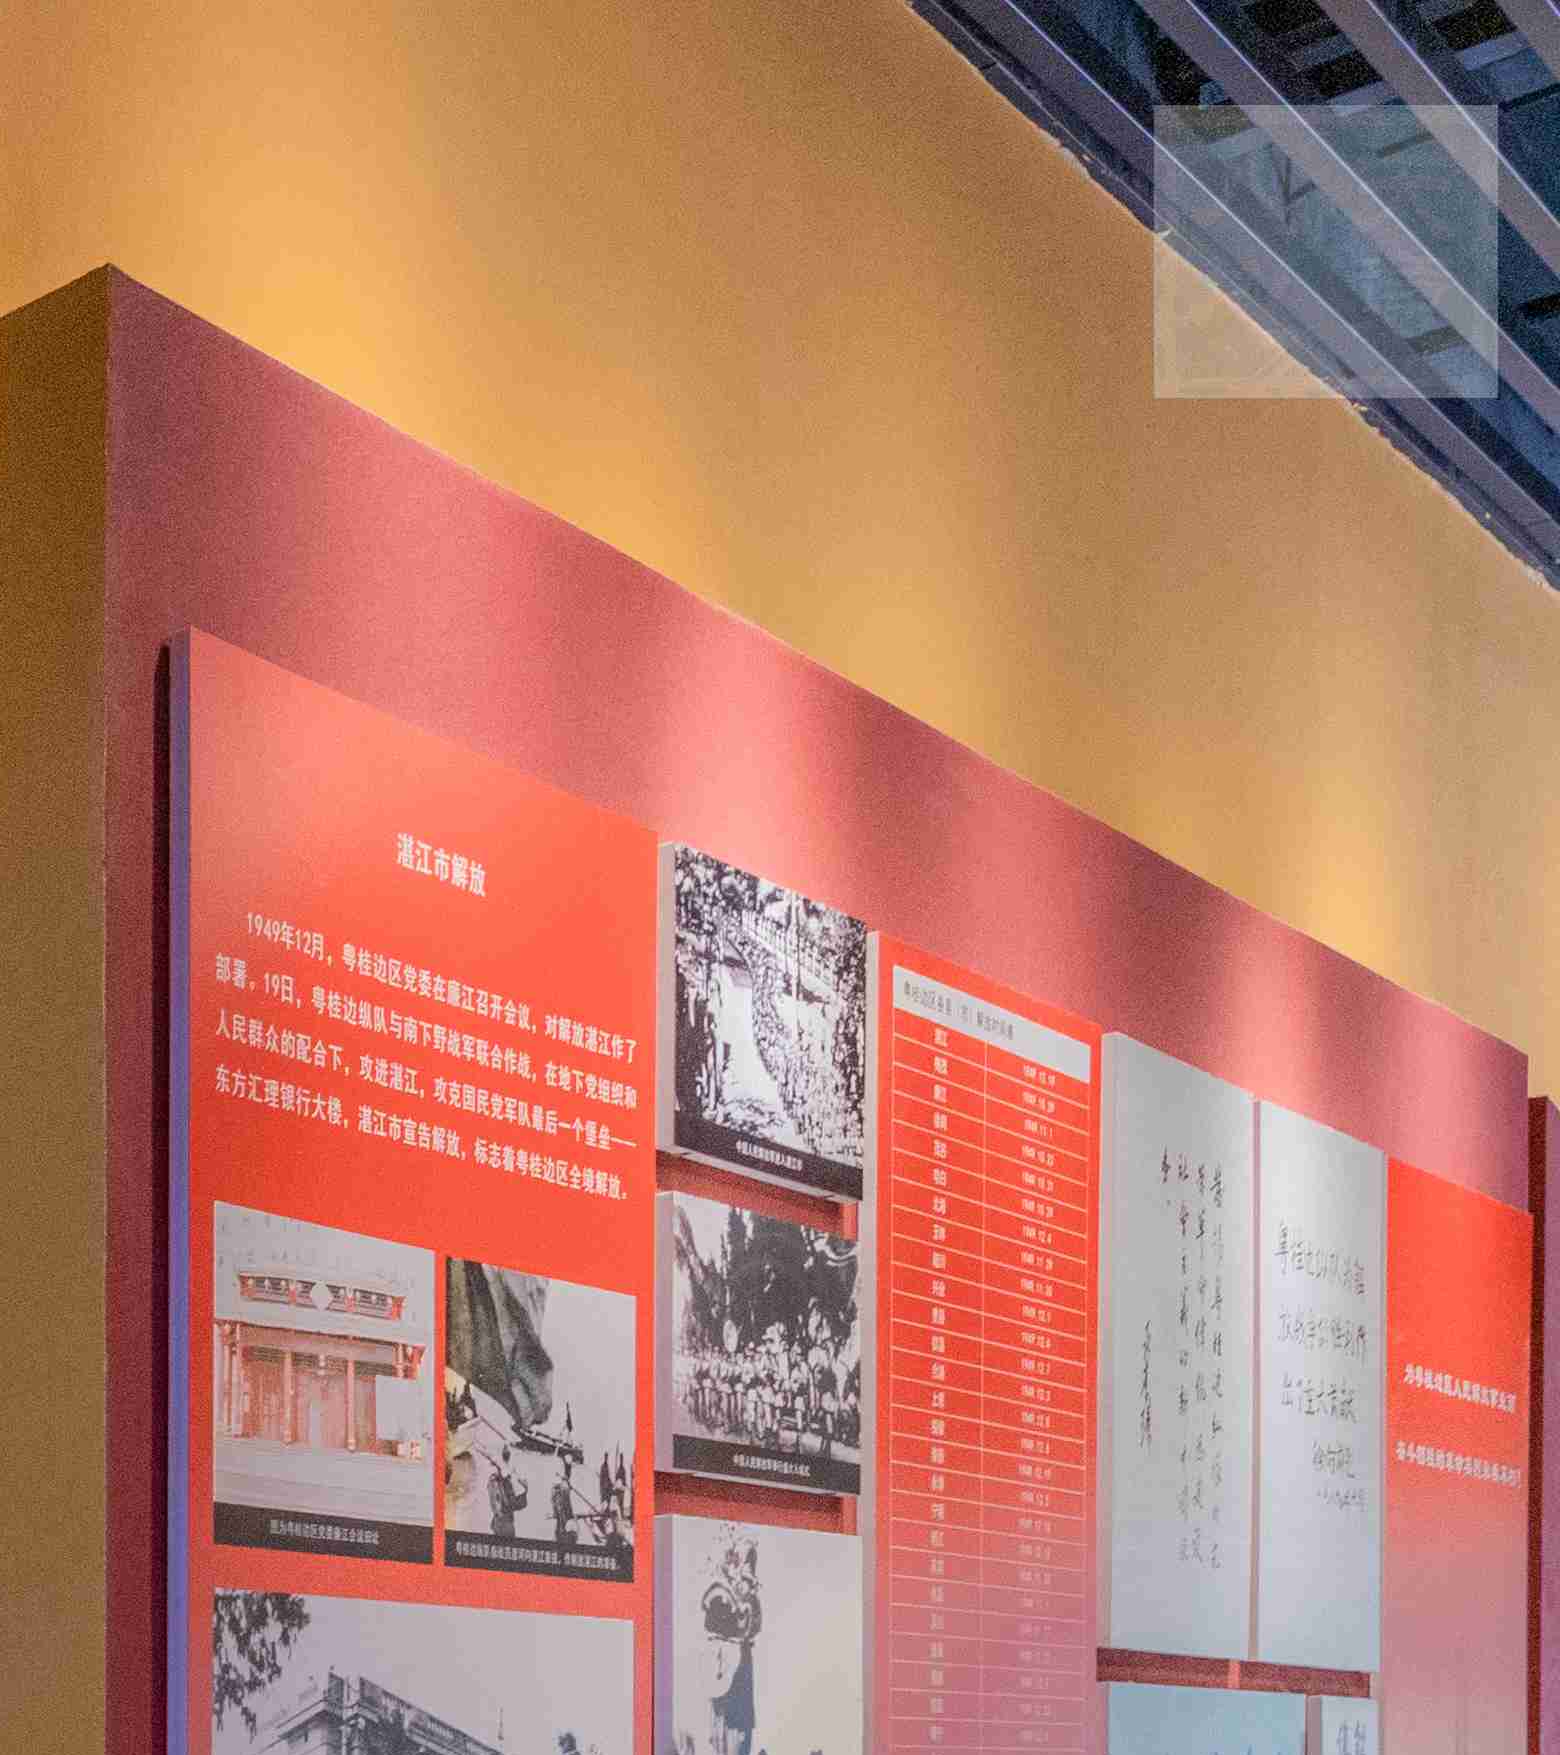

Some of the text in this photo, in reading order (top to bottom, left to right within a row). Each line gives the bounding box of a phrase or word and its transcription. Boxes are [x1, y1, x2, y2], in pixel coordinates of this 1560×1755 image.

[395, 829, 486, 899] 湛江市解放
